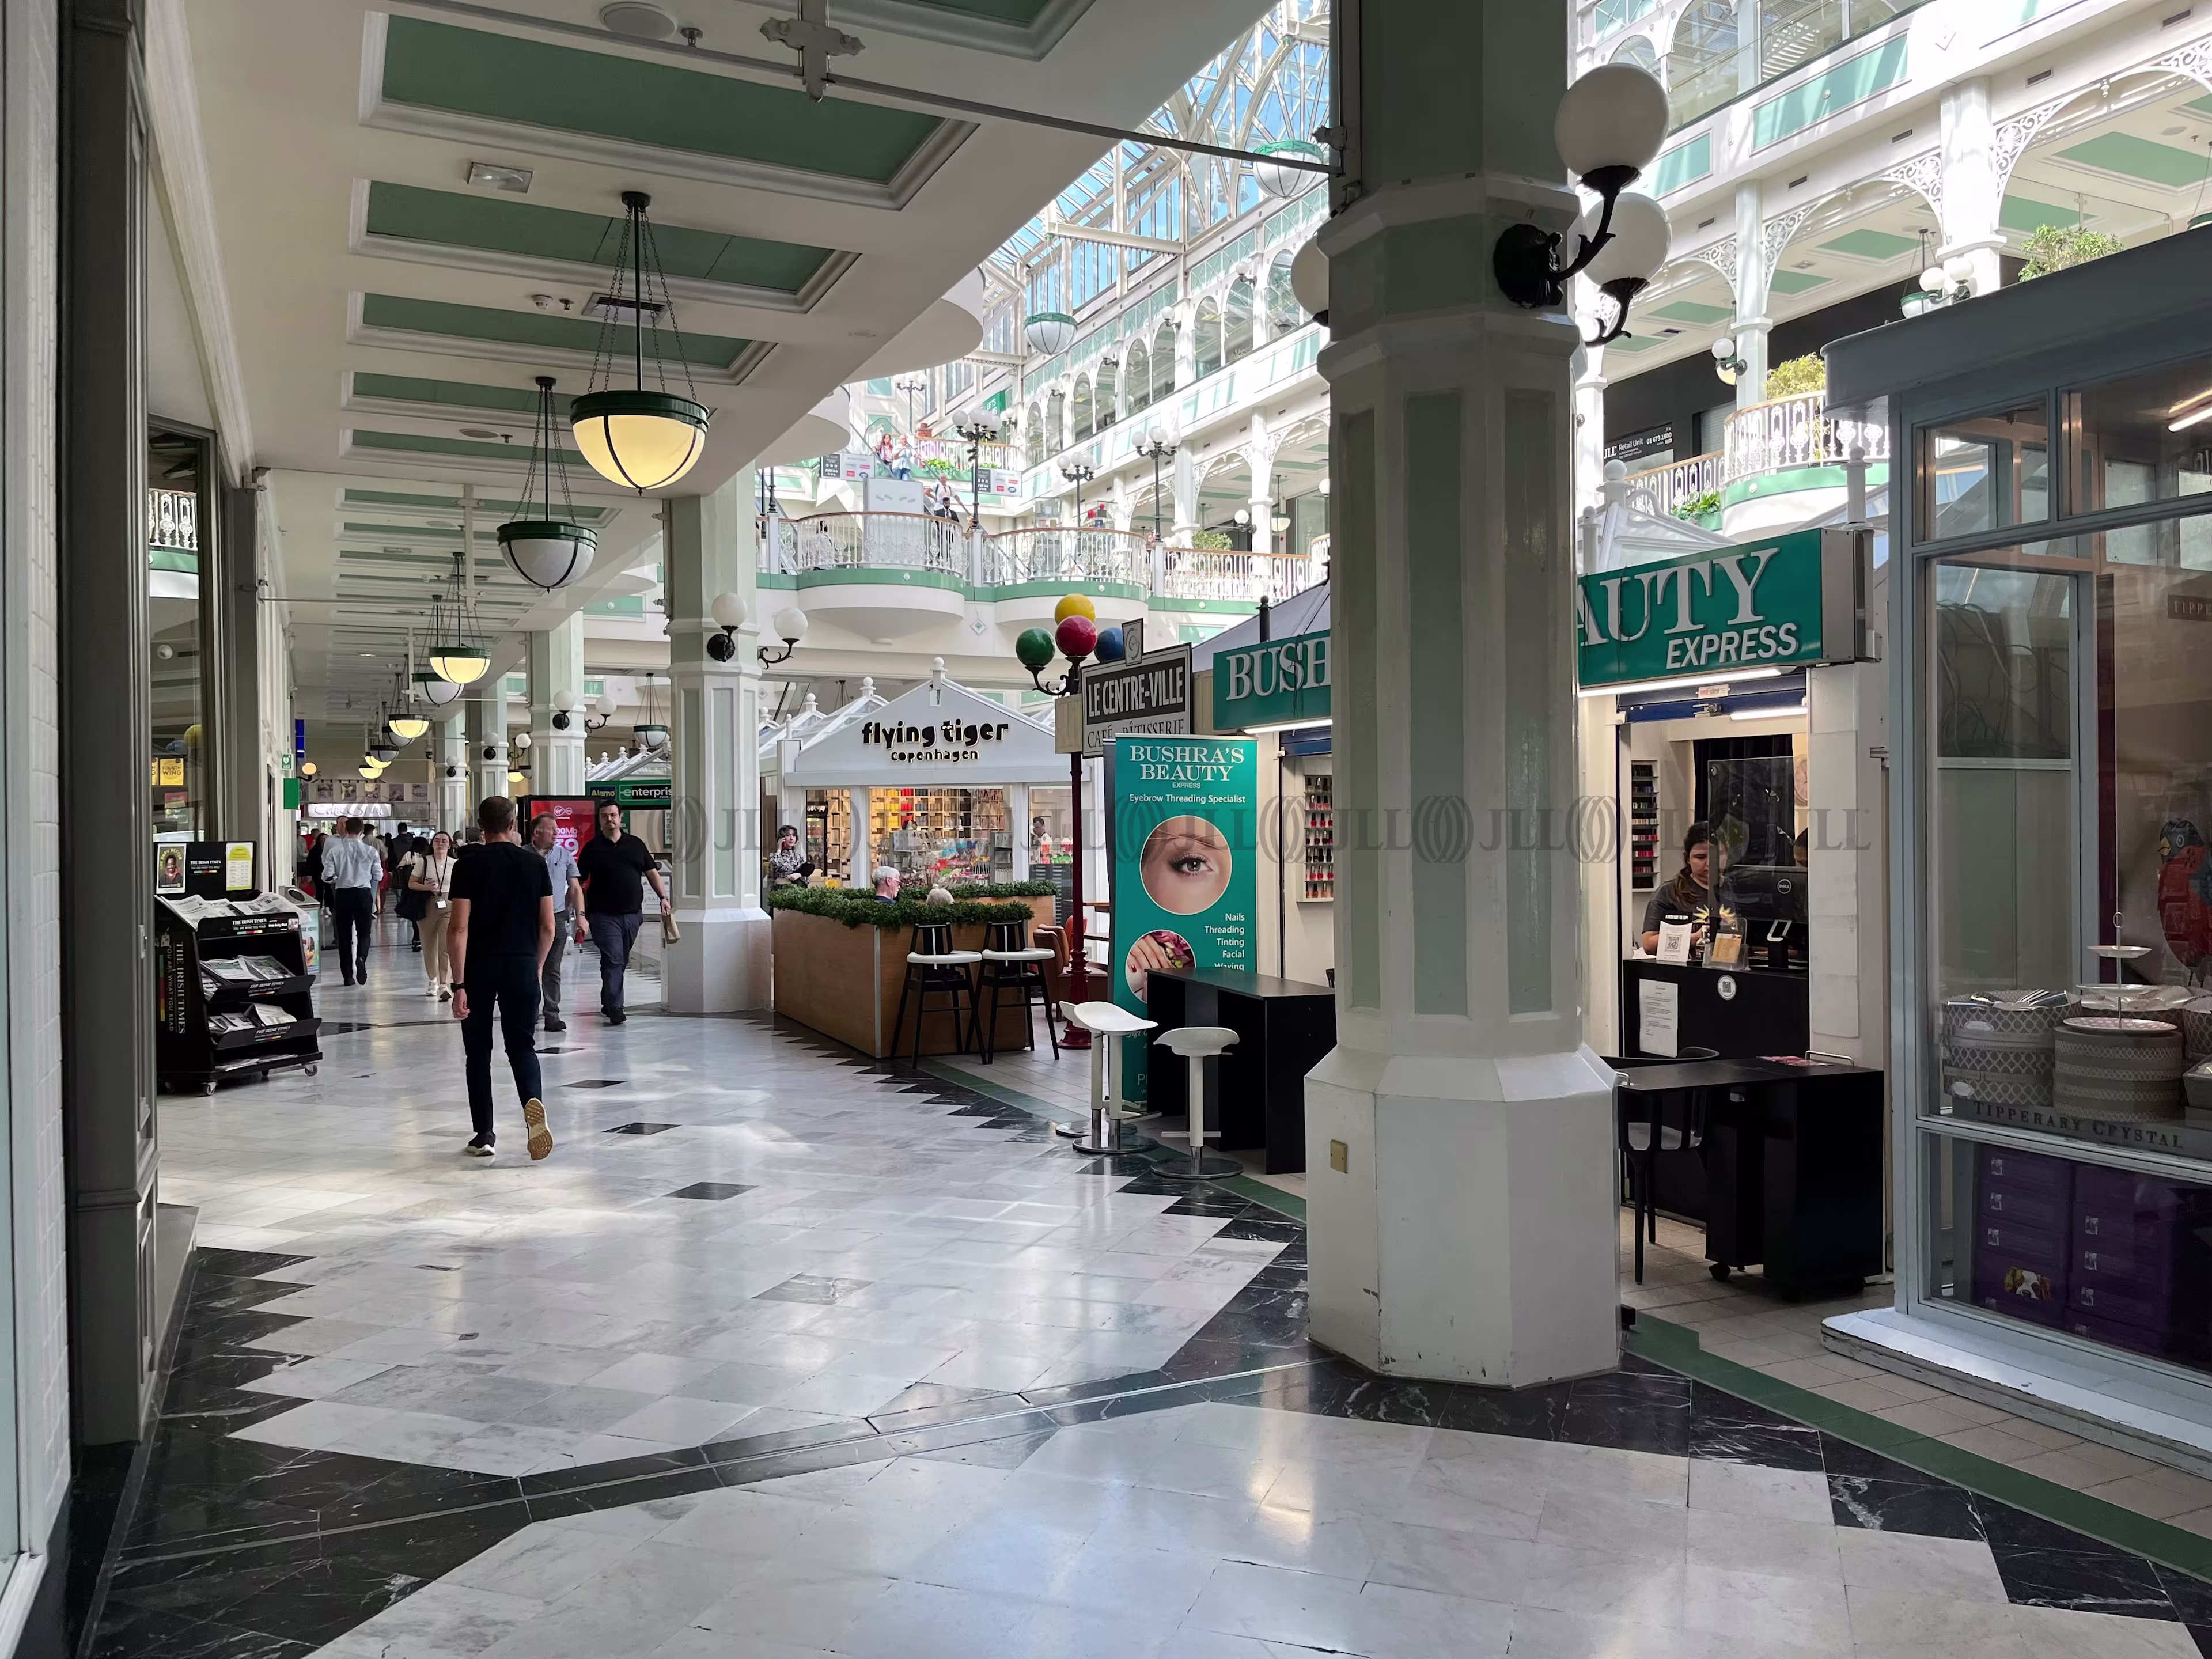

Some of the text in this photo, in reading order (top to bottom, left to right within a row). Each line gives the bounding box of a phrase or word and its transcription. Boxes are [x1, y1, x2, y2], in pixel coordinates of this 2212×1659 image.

[1619, 441, 1633, 451] Retail
[1633, 438, 1643, 447] Unit
[1666, 622, 1798, 669] EXPRESS
[1226, 636, 1331, 700] BUSH
[1088, 666, 1184, 718] LE CENTRE-VILLE
[862, 718, 1010, 749] flying tiger
[891, 749, 979, 763] copenhagen
[1130, 745, 1244, 764] BUSHRA'S
[1140, 764, 1233, 781] BEAUTY
[1130, 794, 1245, 804] Eyebrow Threading Specialist
[1225, 913, 1245, 921] Nails
[1204, 925, 1245, 935] Threading
[1217, 938, 1244, 948] Tinting
[177, 967, 185, 997] IRISH
[177, 999, 185, 1034] TIMES
[1973, 1101, 2083, 1132] TIPPERARY
